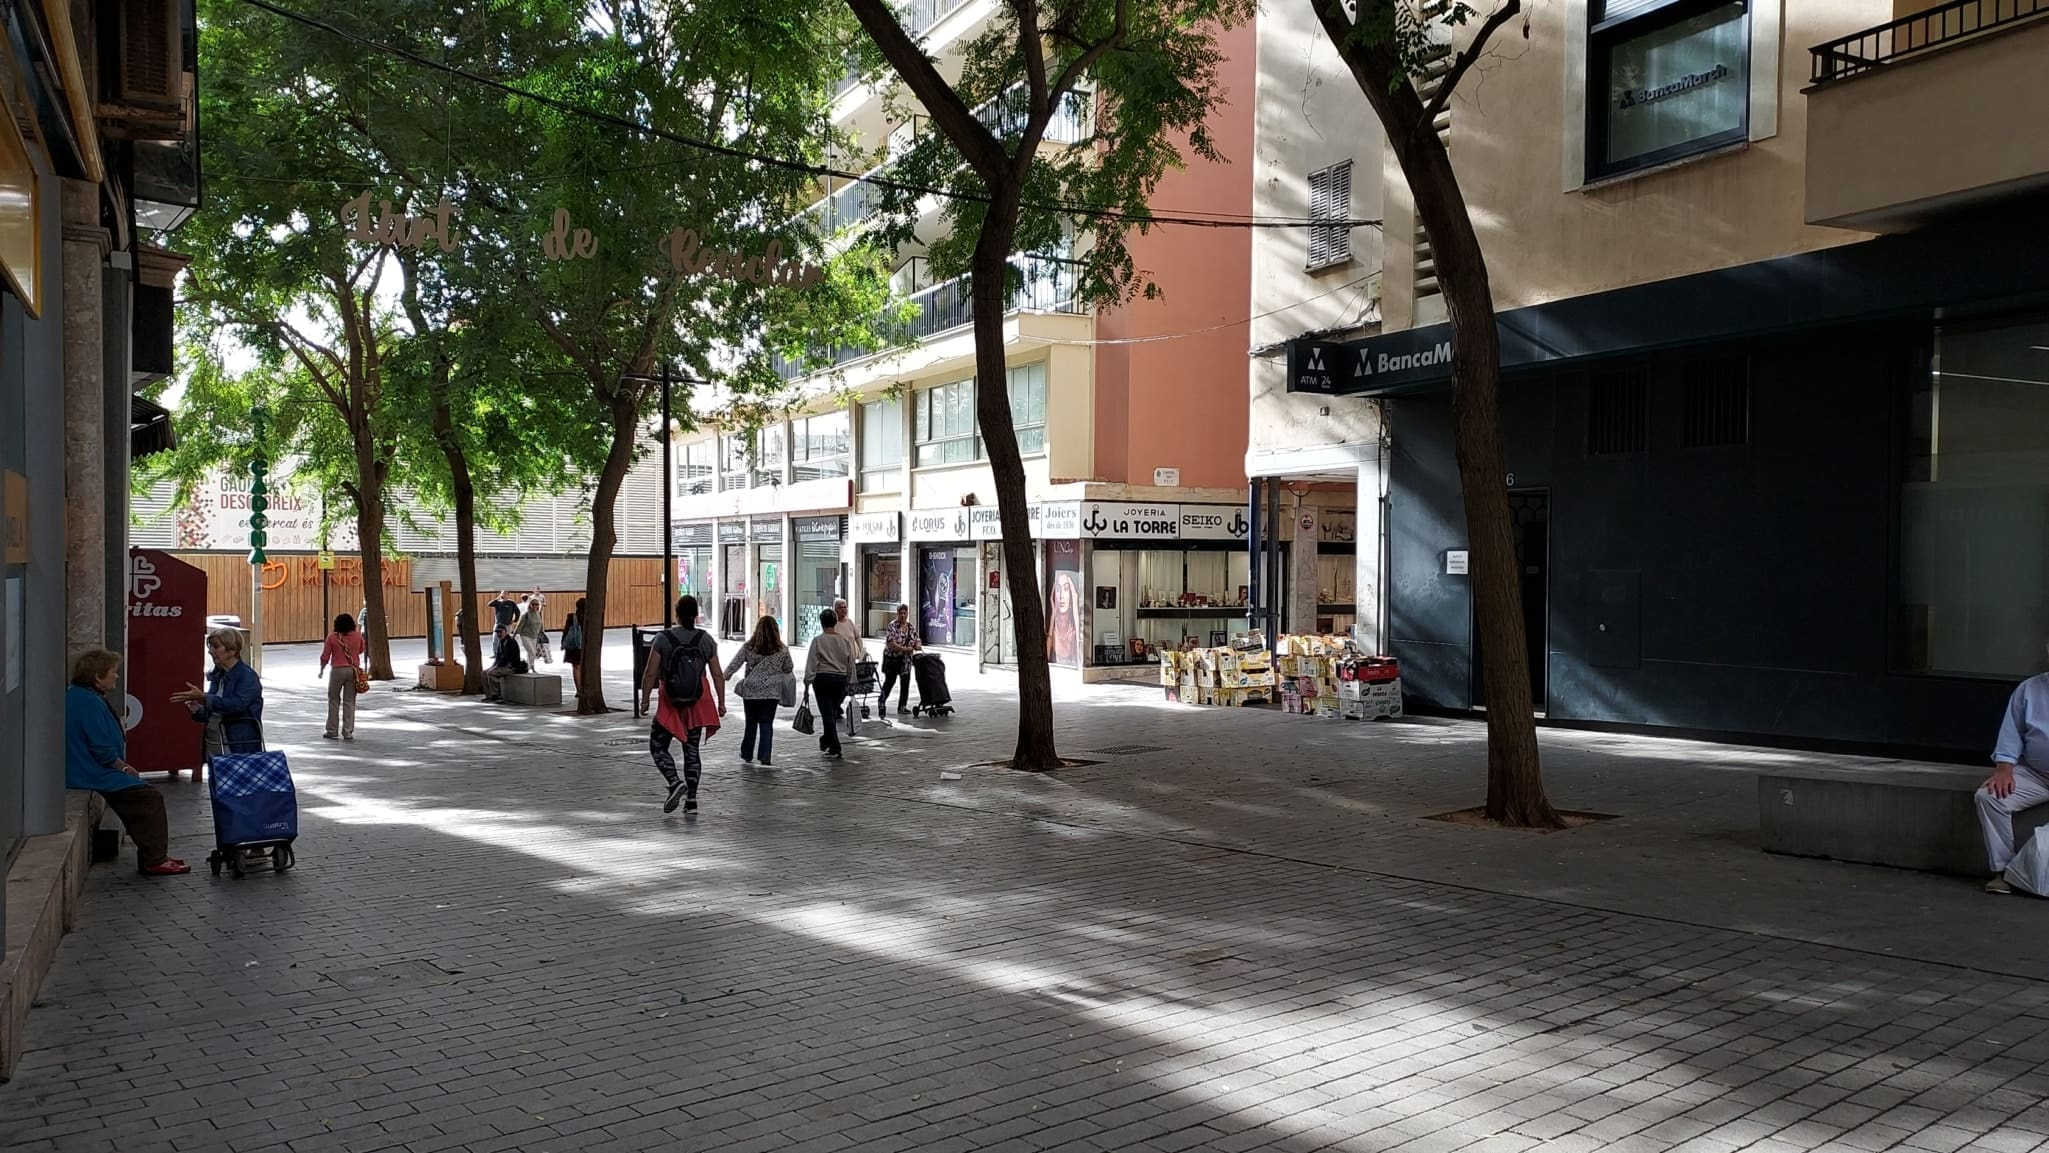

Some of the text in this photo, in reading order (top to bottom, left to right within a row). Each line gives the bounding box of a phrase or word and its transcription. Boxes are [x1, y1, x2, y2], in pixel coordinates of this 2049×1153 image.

[1639, 64, 1728, 104] BancaMarch
[543, 208, 598, 261] de
[1378, 341, 1455, 373] BancaM
[1300, 375, 1332, 385] ATM 24
[220, 494, 302, 511] DESCBREIX
[972, 509, 1000, 523] JOYERIA
[1045, 507, 1077, 519] Joiers
[1124, 508, 1166, 518] JOYERIA
[919, 516, 945, 530] LORUS
[1113, 520, 1177, 534] LA TORRE
[1182, 514, 1222, 527] SEIKO
